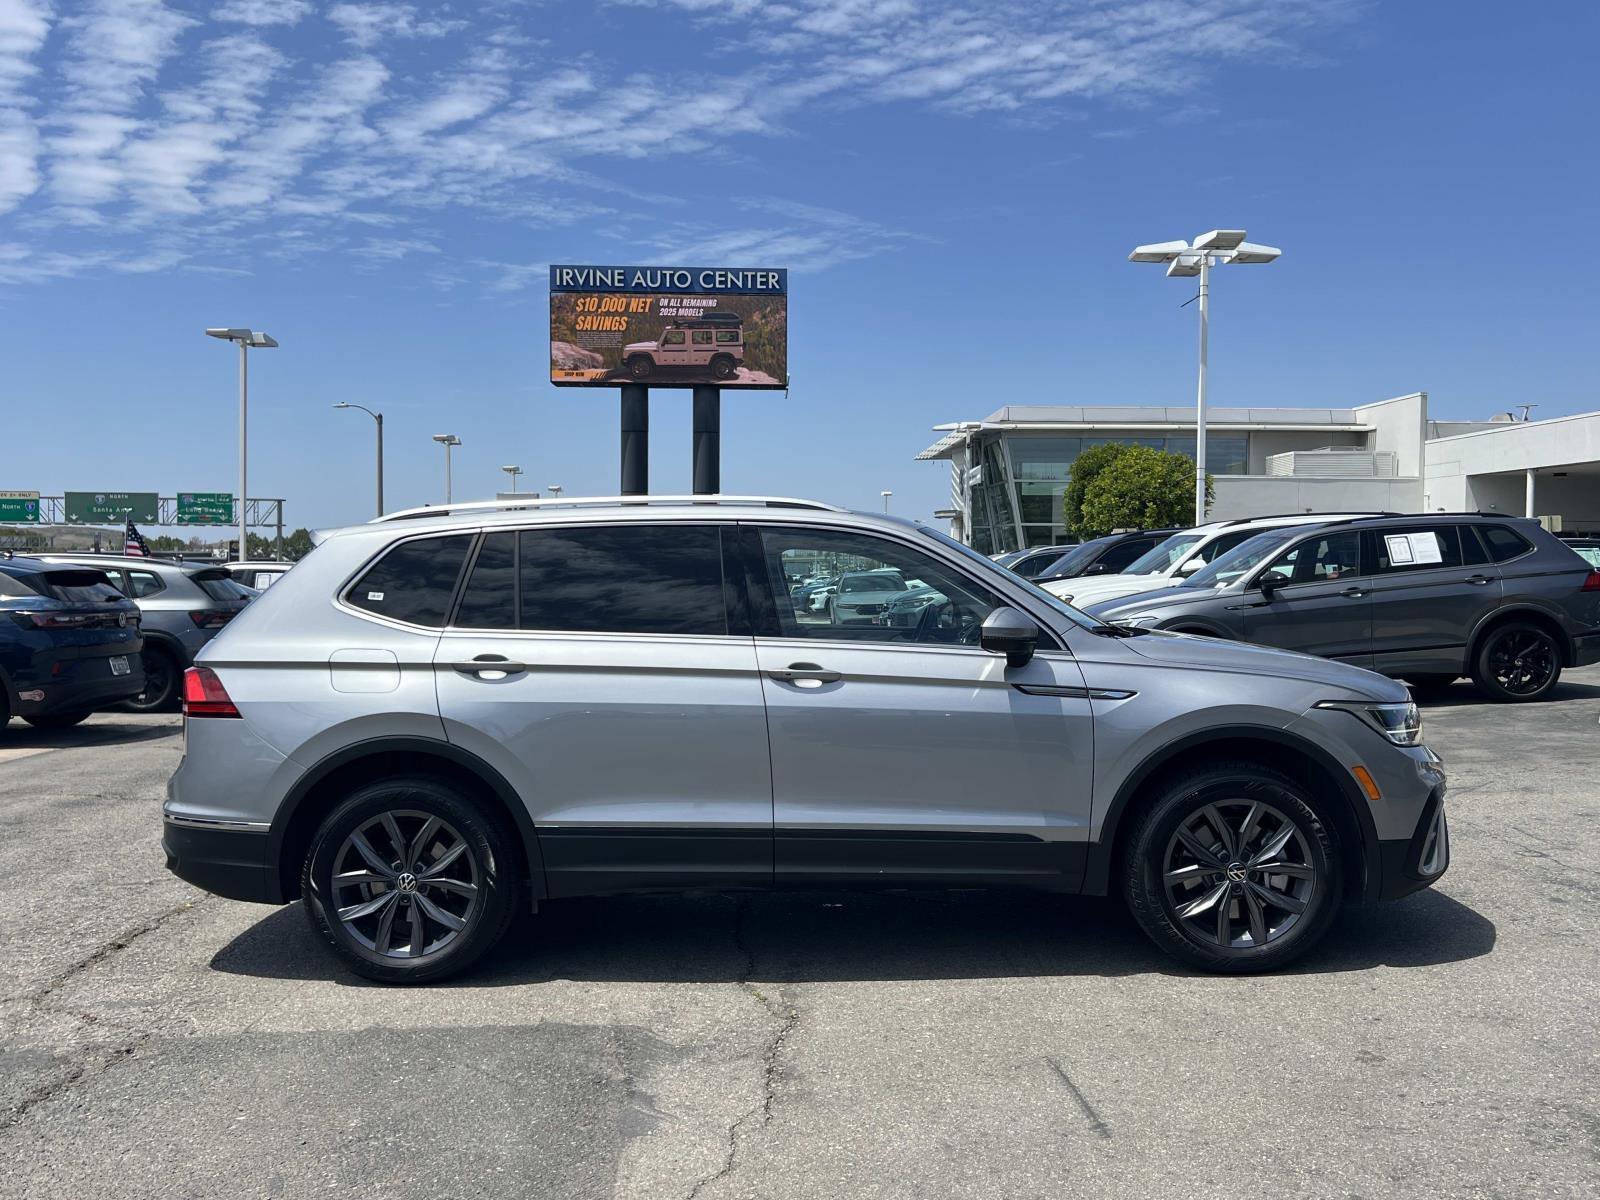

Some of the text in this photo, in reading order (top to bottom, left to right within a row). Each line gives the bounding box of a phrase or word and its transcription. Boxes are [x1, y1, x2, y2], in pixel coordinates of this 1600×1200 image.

[556, 268, 780, 289] IRVINE AUTO CENTER
[576, 296, 653, 314] $10,000 NET
[659, 298, 718, 307] ON ALL REMAINING
[659, 307, 704, 317] 2025 MODELS
[576, 315, 628, 332] SAVINGS
